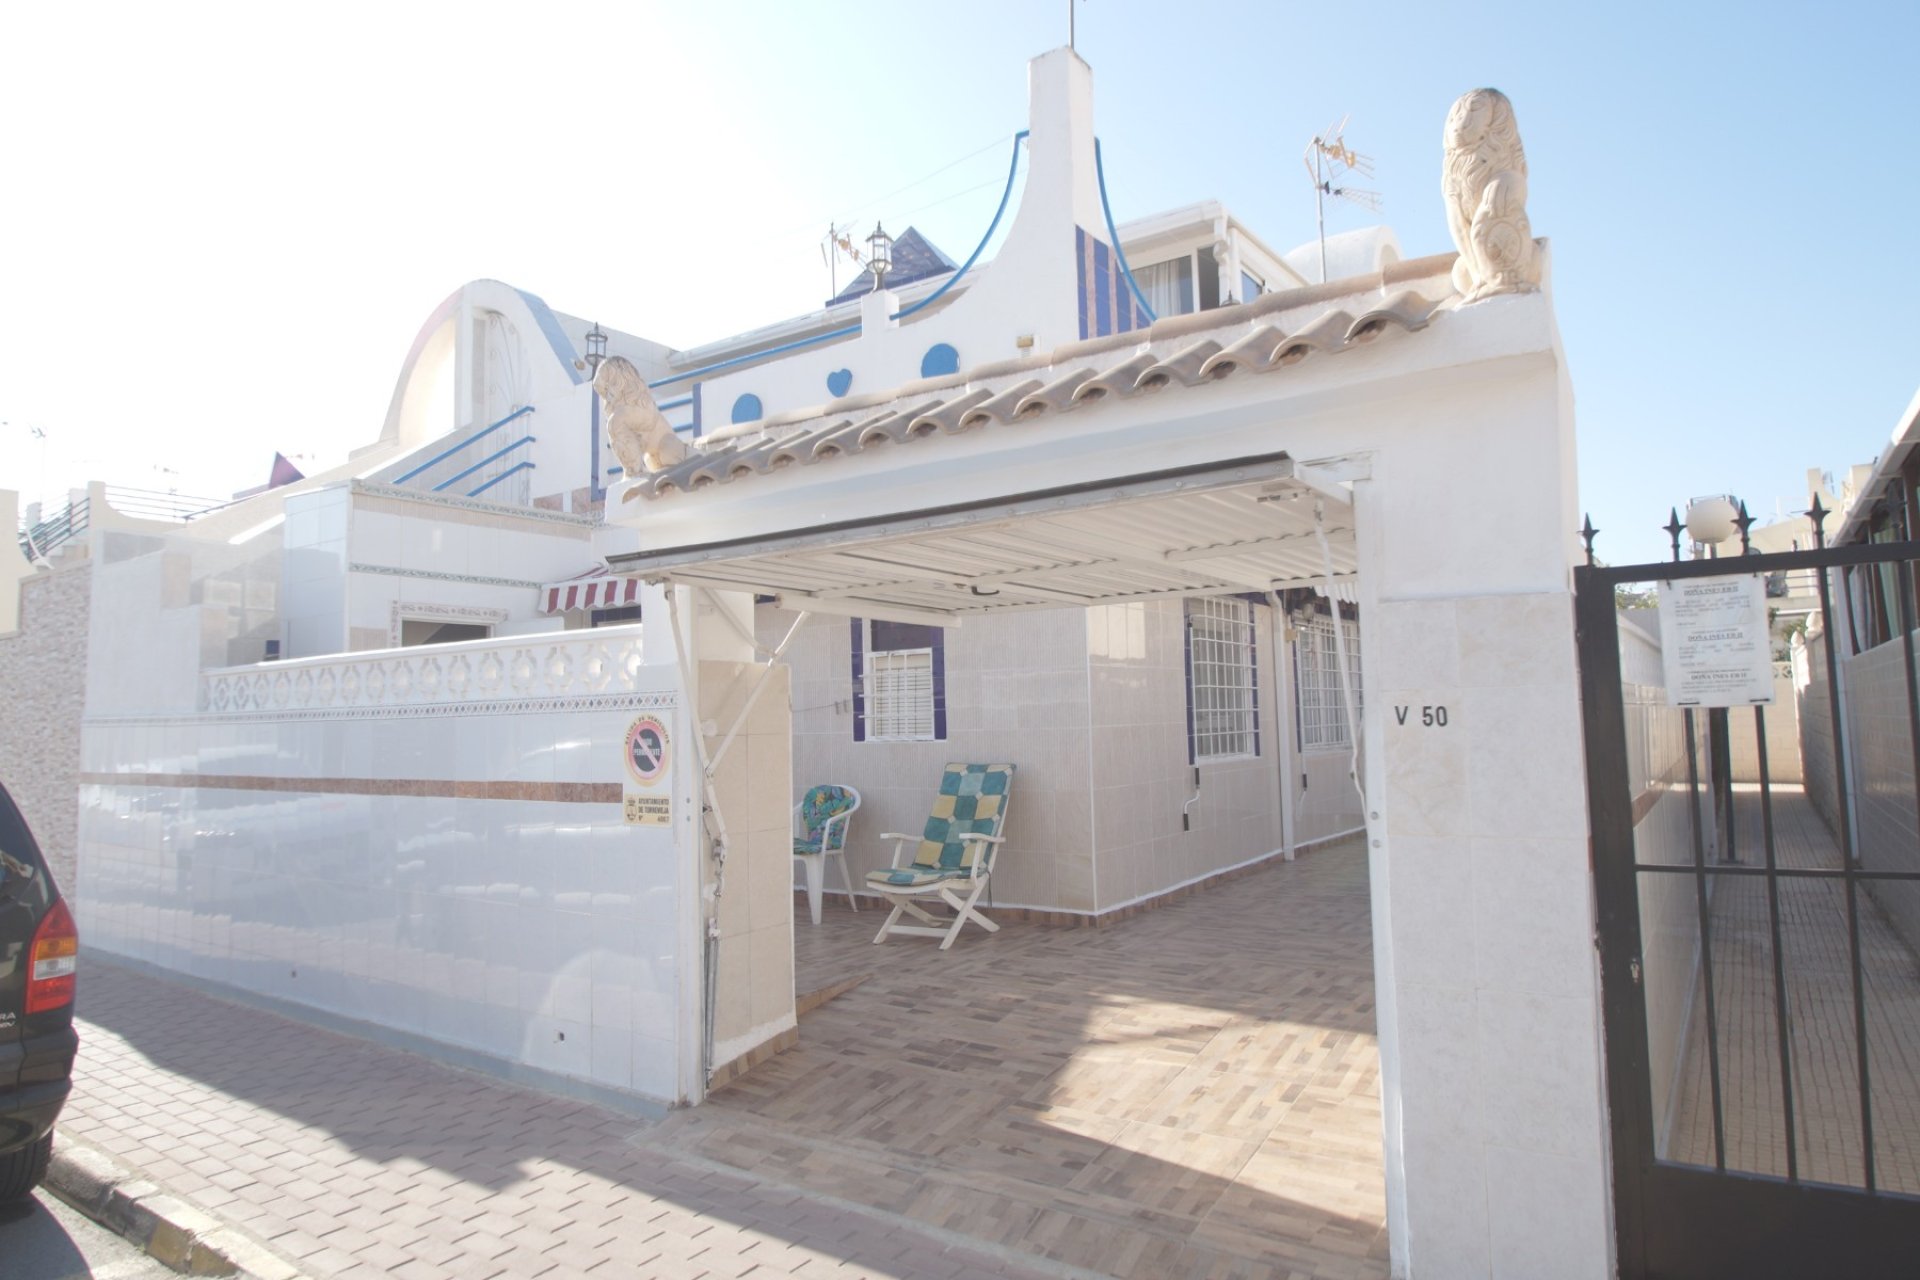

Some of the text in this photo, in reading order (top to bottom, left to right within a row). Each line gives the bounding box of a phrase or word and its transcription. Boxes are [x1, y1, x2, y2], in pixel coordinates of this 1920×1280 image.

[1394, 705, 1448, 727] V 50
[638, 806, 644, 814] DE
